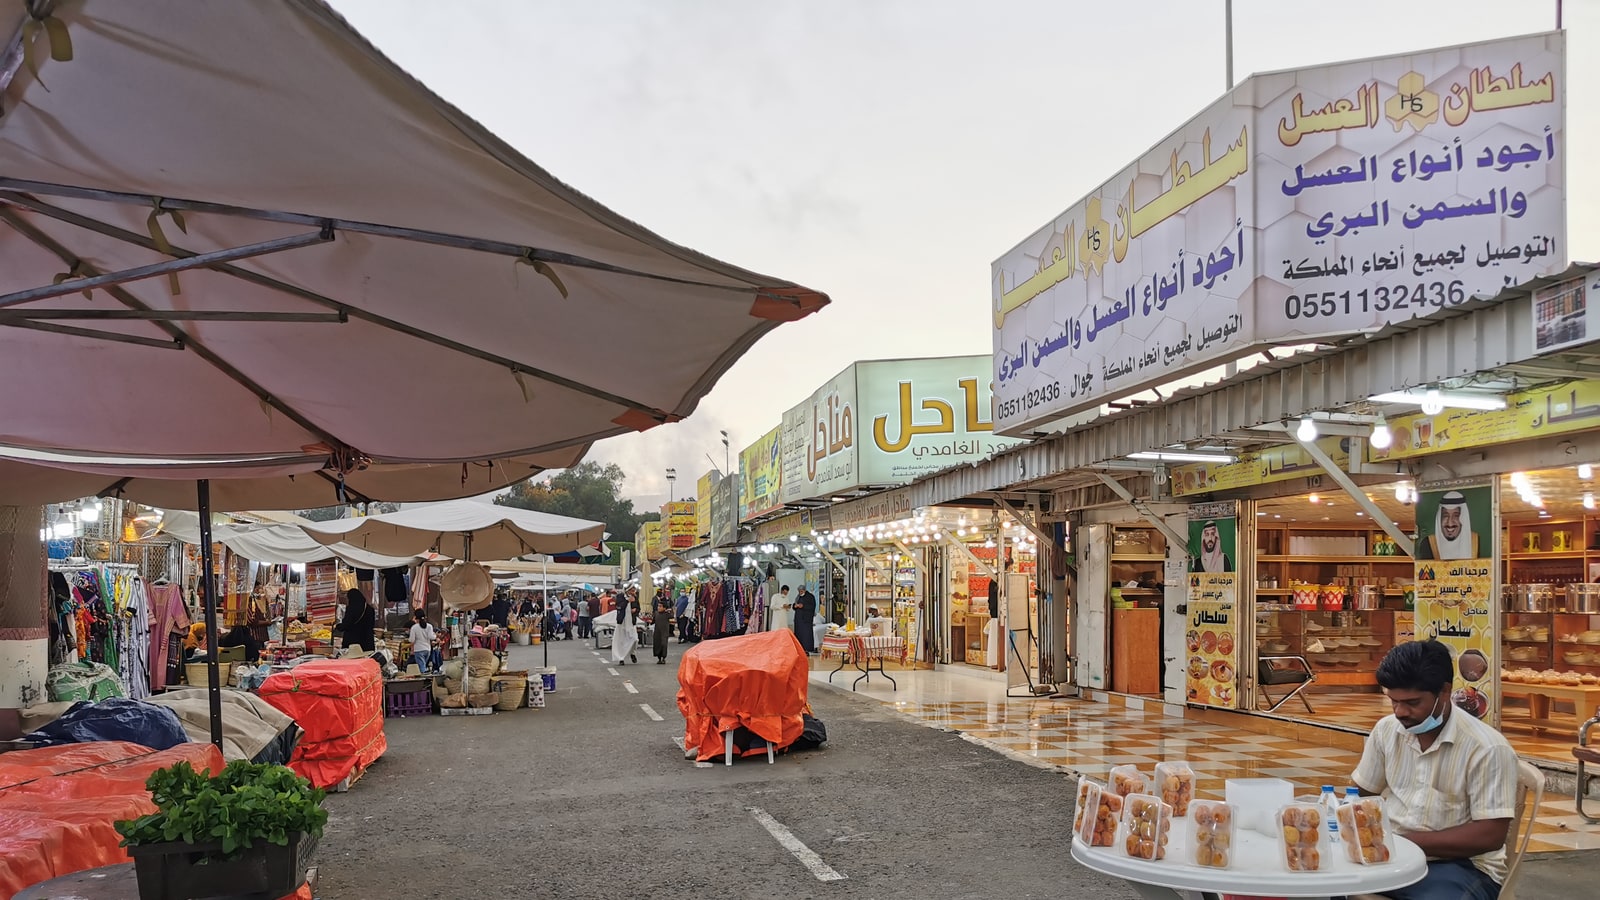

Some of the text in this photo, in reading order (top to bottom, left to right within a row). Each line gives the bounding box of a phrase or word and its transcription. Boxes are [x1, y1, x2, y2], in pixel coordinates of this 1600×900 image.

[1278, 62, 1554, 146] سلطان العسل
[1401, 93, 1423, 112] HS
[1282, 124, 1554, 196] أجود أنواع العسل
[994, 124, 1248, 329] سلطان العسل
[1306, 187, 1528, 245] والسمن البري
[1283, 235, 1555, 280] التوصيل لجميع أنحاء المملكة
[998, 218, 1244, 388] أجود أنواع العسل والسمن البري
[1285, 280, 1464, 320] 0551132436
[1197, 314, 1242, 352] التوصيل
[1139, 341, 1160, 368] أنحاء
[1164, 334, 1192, 366] لجميع
[1071, 372, 1094, 397] جوال
[1103, 356, 1135, 381] المملكة
[874, 377, 993, 452] احل
[998, 381, 1060, 420] 0551132436
[808, 394, 852, 482] مناحل
[913, 440, 979, 460] الغامدي
[1465, 567, 1488, 577] مرحبا
[1440, 586, 1459, 596] عسير
[1460, 584, 1472, 598] في
[1193, 611, 1228, 627] سلطان
[1464, 608, 1488, 616] مناحل
[1430, 619, 1471, 639] سلطان
